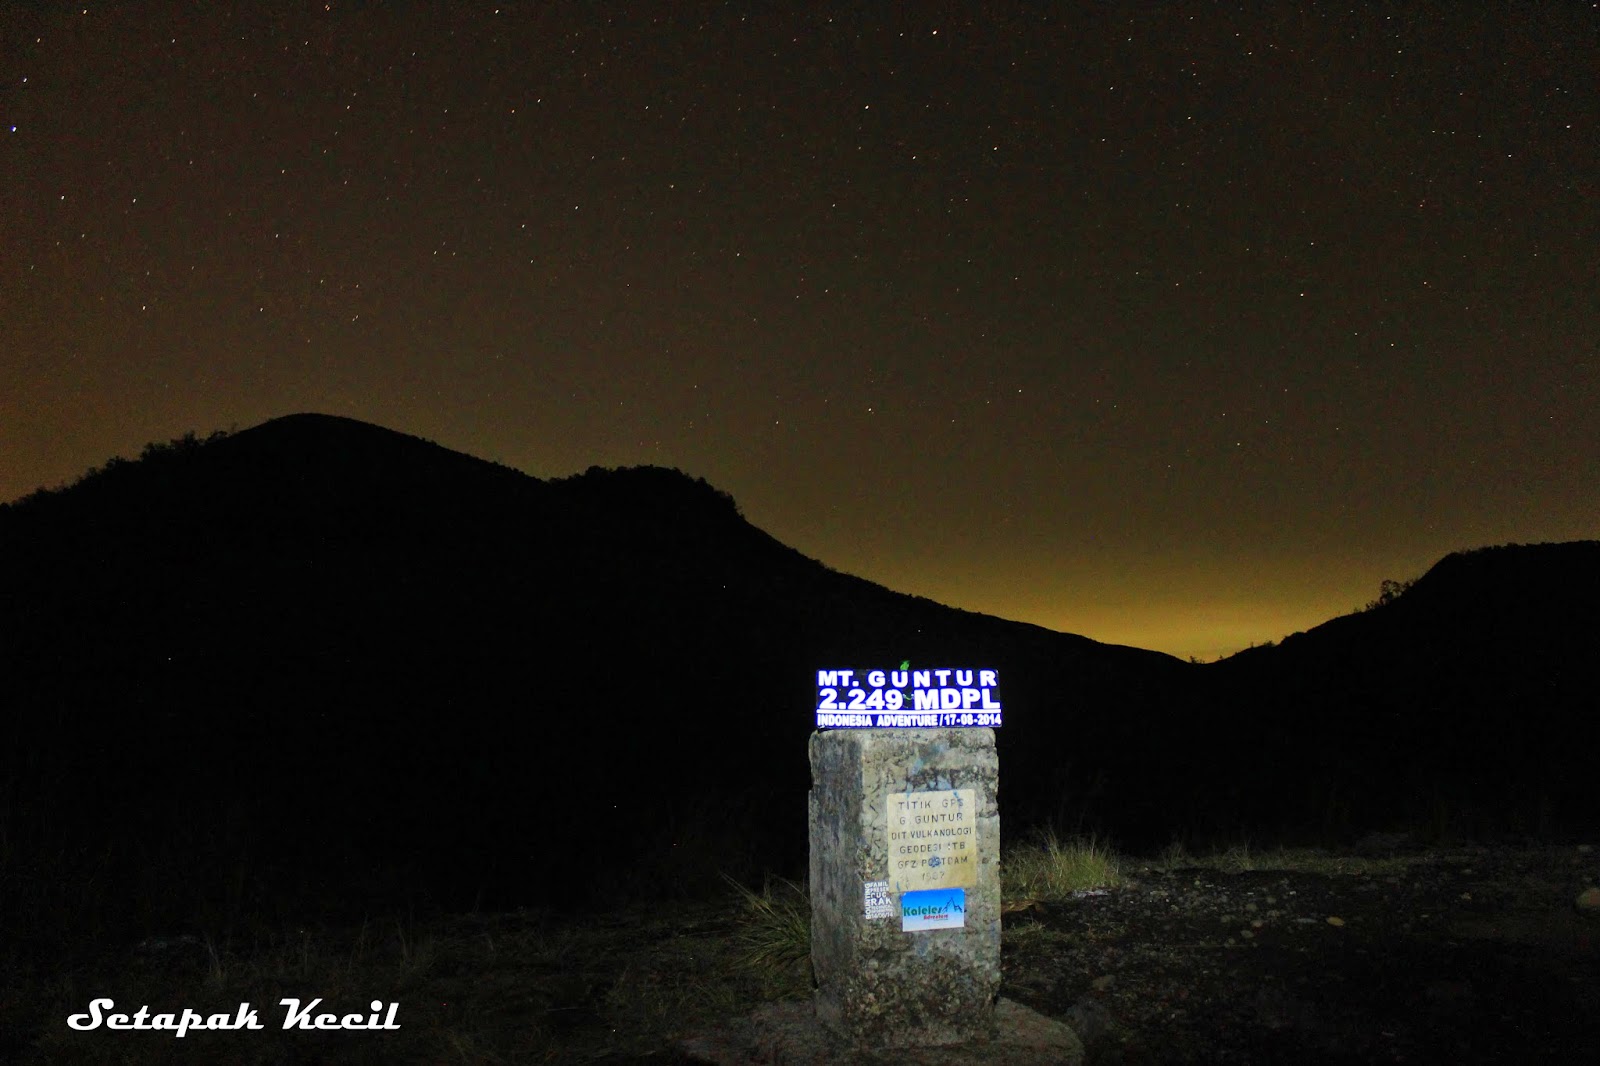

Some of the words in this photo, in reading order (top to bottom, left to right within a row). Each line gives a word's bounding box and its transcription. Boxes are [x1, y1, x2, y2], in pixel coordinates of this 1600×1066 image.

[817, 670, 860, 687] MT.
[868, 670, 998, 687] GUNTUR
[819, 688, 904, 710] 2.249
[914, 688, 1001, 710] MDPL
[817, 714, 873, 727] INDONESIA
[898, 800, 932, 810] TITIK
[942, 798, 964, 808] GPS
[915, 813, 963, 825] GUNTUR
[910, 827, 972, 838] VULKANOLOGI
[899, 843, 942, 854] GEODESI
